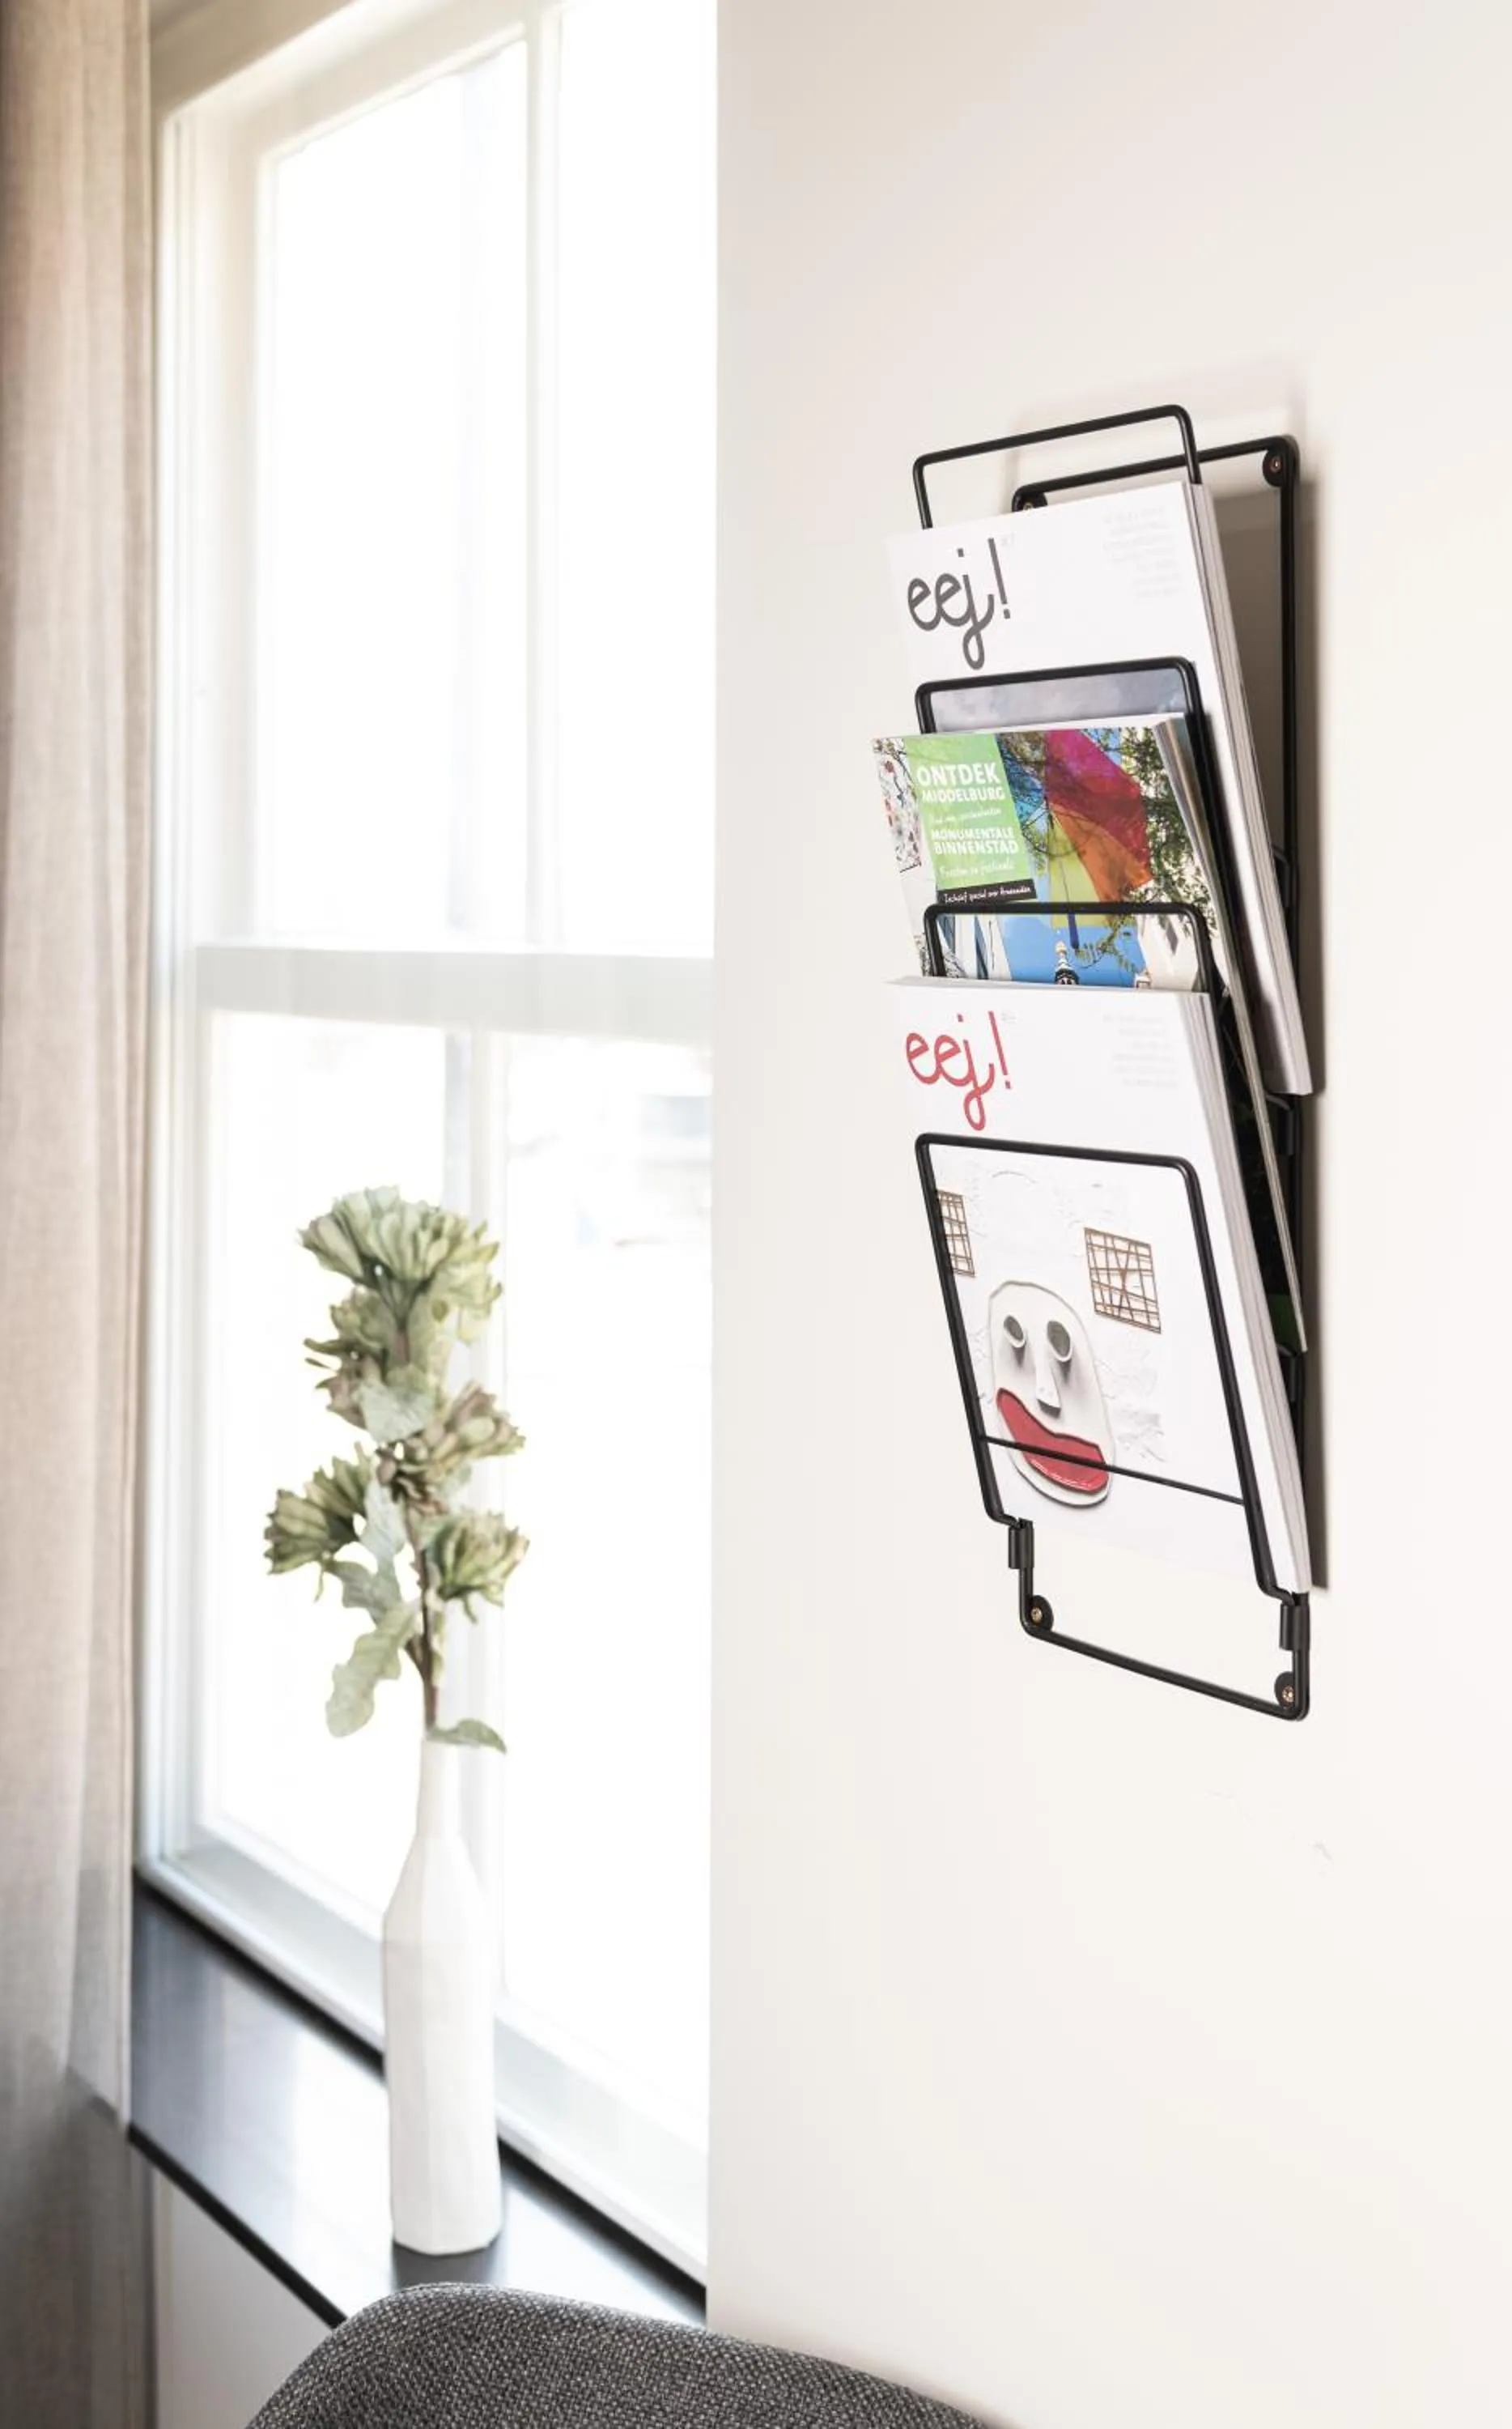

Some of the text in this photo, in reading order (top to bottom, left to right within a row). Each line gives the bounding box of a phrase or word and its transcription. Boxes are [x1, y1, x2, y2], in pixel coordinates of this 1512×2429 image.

[917, 762, 1000, 786] ONTDEK
[921, 787, 1004, 803] MIDDELBURG
[932, 827, 1014, 840] MONUMENTALE
[934, 840, 1018, 855] BINNENSTAD
